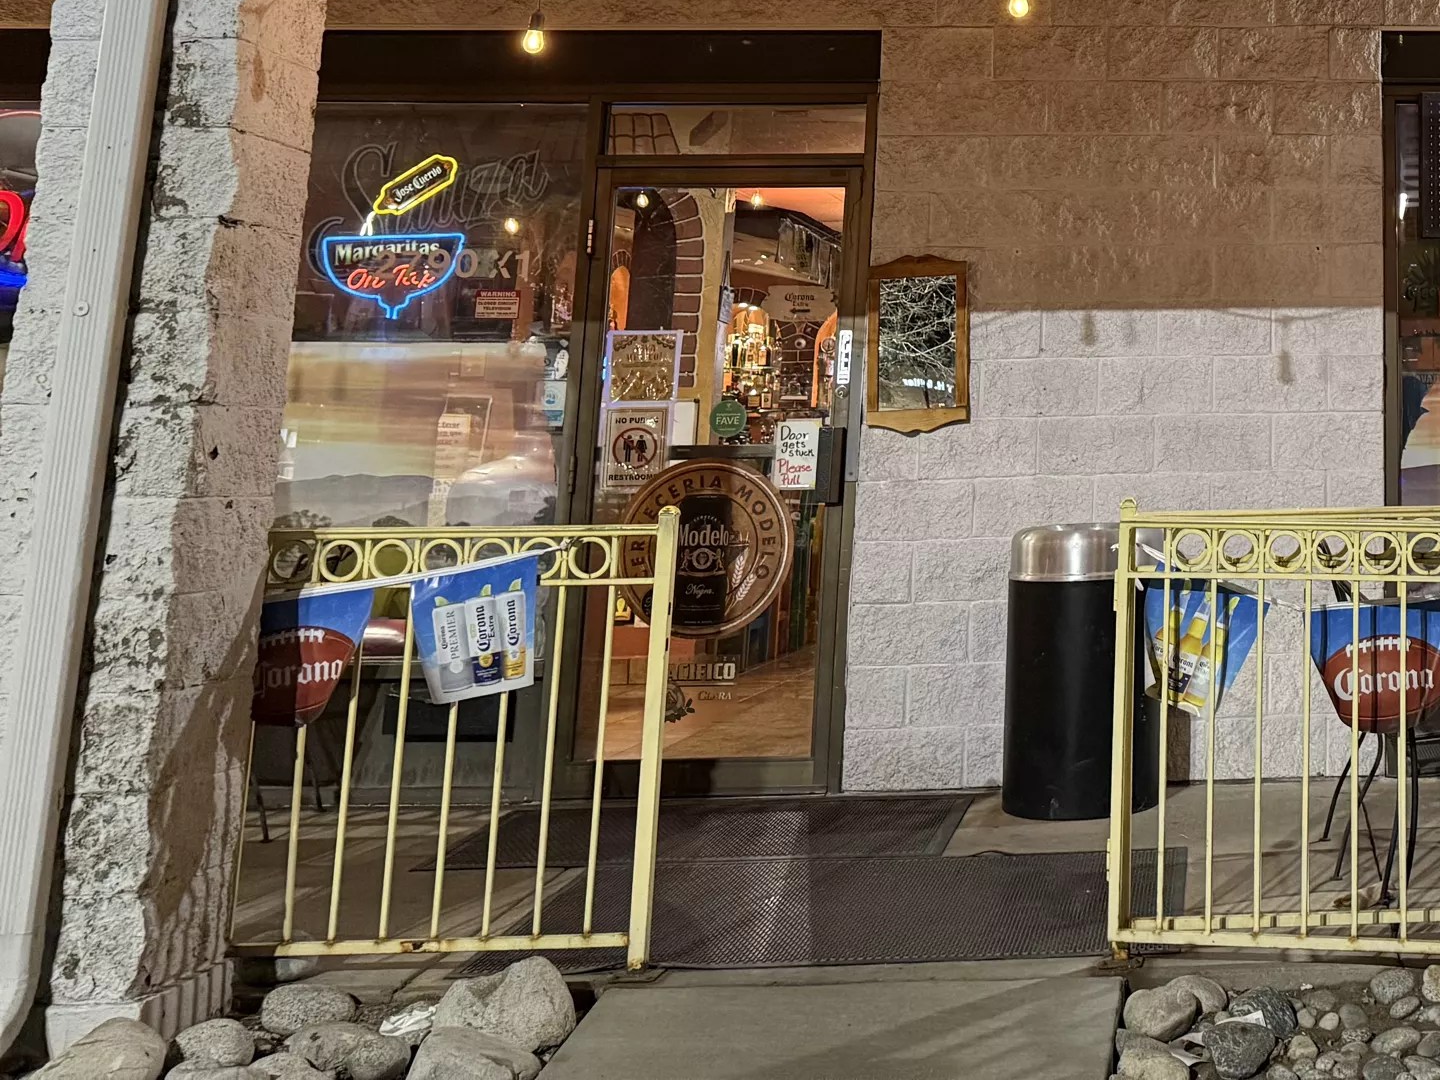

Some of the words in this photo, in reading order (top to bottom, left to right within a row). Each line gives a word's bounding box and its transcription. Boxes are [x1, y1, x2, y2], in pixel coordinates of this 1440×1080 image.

[346, 268, 386, 290] On
[715, 416, 740, 426] FAVE
[780, 425, 809, 441] Door
[781, 440, 806, 453] gets
[788, 447, 815, 457] stuck
[777, 459, 812, 474] Please
[781, 473, 801, 486] Pull
[679, 524, 730, 546] Modelo
[734, 484, 777, 580] MODELO
[477, 605, 491, 652] Corona
[508, 599, 519, 645] Corona
[450, 611, 460, 660] PREMIER
[1334, 666, 1435, 701] Corona
